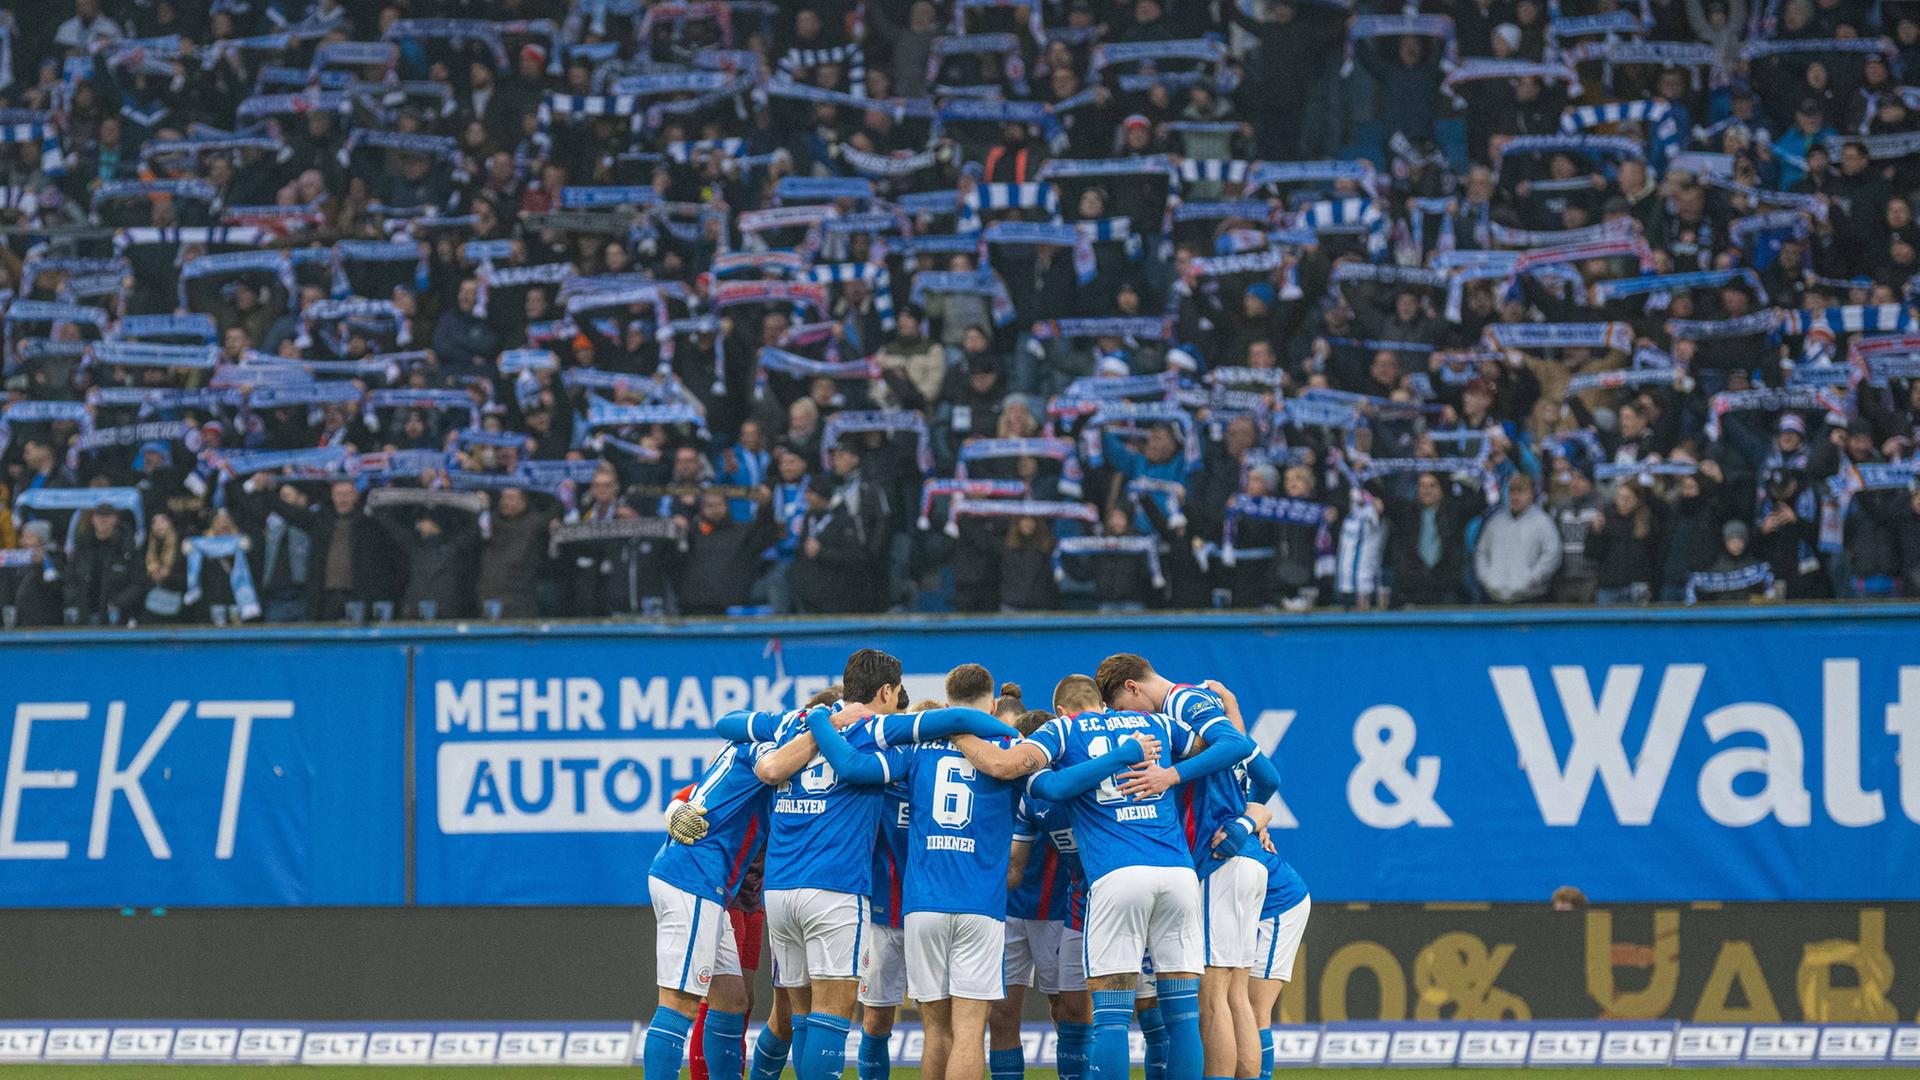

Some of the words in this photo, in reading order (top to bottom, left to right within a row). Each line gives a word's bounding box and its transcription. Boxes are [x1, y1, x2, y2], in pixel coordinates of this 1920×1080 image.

[435, 679, 604, 733] MEHR
[620, 675, 843, 731] MARKE
[1346, 704, 1454, 829] &
[0, 701, 295, 860] EKT
[932, 755, 976, 830] 6
[1115, 804, 1158, 822] MEJDR
[0, 1035, 39, 1050] LT
[52, 1035, 103, 1050] SLT
[115, 1035, 167, 1050] SLT
[179, 1035, 231, 1050] SLT
[243, 1035, 296, 1050] SLT
[309, 1039, 358, 1054] SLT
[374, 1039, 425, 1054] SLT
[440, 1039, 490, 1054] SLT
[506, 1039, 556, 1054] SLT
[571, 1039, 621, 1054] SLT
[1280, 1038, 1314, 1053] LT
[1328, 1039, 1380, 1053] SLT
[1398, 1039, 1450, 1053] SLT
[1468, 1039, 1520, 1053] SLT
[1538, 1039, 1590, 1053] SLT
[1609, 1039, 1666, 1053] SLT
[1683, 1035, 1739, 1049] SLT
[1754, 1035, 1811, 1049] SLT
[1827, 1035, 1883, 1049] SLT
